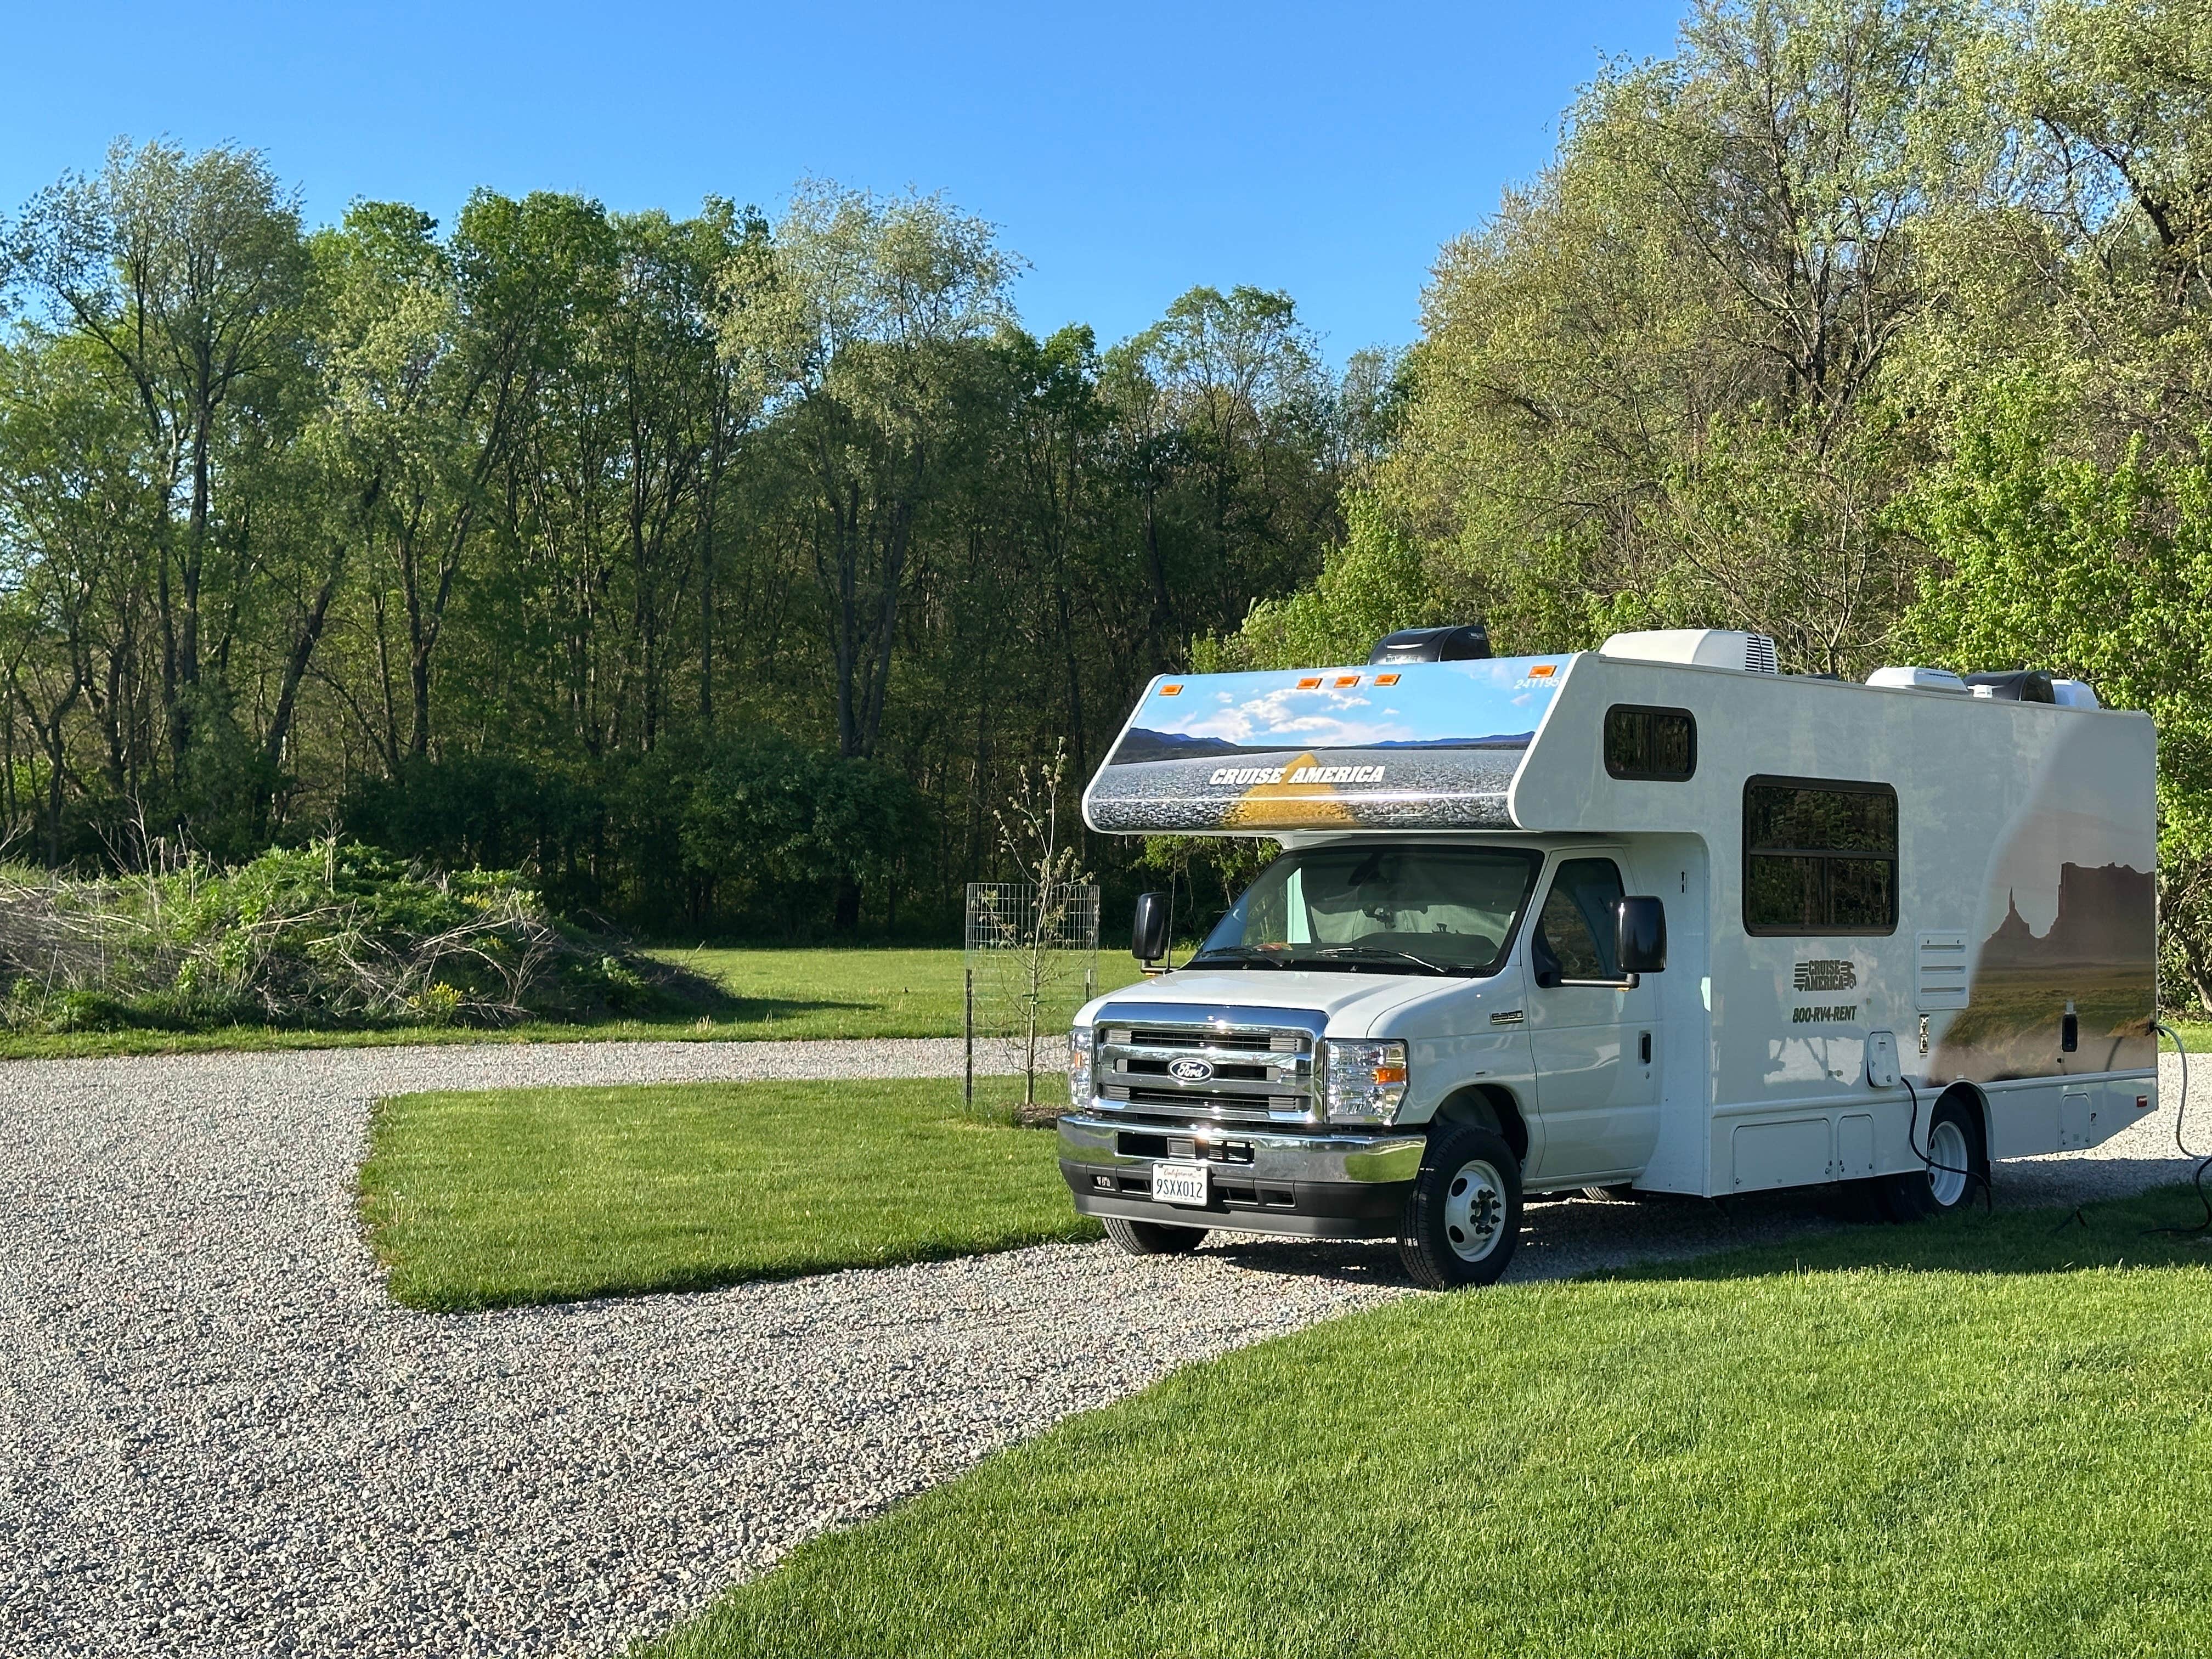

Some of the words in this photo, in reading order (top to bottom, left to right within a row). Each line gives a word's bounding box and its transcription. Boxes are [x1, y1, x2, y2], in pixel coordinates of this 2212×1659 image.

[1209, 768, 1287, 785] CRUISE
[1288, 765, 1386, 784] AMERICA
[1808, 960, 1841, 975] CRUISE
[1804, 975, 1845, 991] AMERICA
[1792, 1005, 1857, 1023] 800-RV4-RENT
[1177, 1062, 1204, 1077] Ford
[1164, 1168, 1193, 1178] California
[1156, 1178, 1203, 1199] 9SXX012
